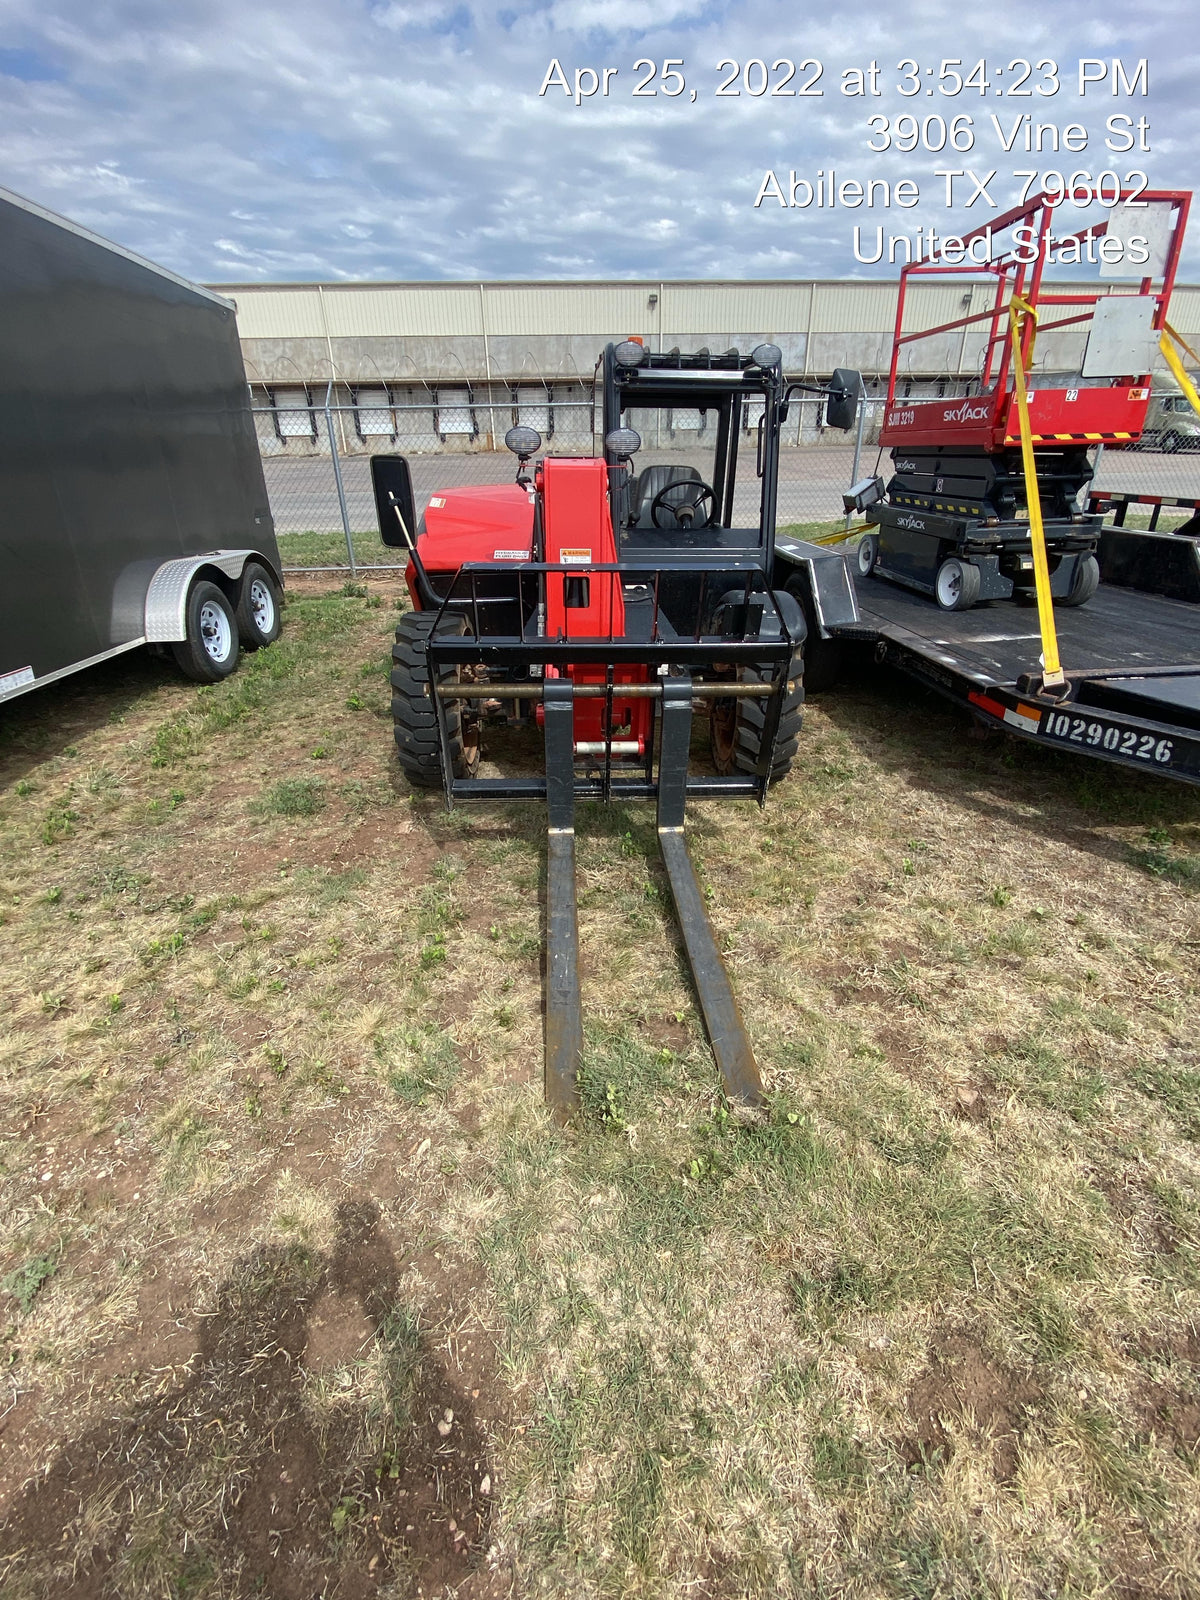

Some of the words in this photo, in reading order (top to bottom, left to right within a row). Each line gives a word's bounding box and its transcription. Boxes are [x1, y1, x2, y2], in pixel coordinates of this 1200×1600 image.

[1066, 389, 1078, 401] 22
[900, 410, 915, 425] 3219
[943, 401, 989, 423] SKYJACK
[896, 515, 926, 530] SKYJACK
[1045, 712, 1174, 763] 10290226
